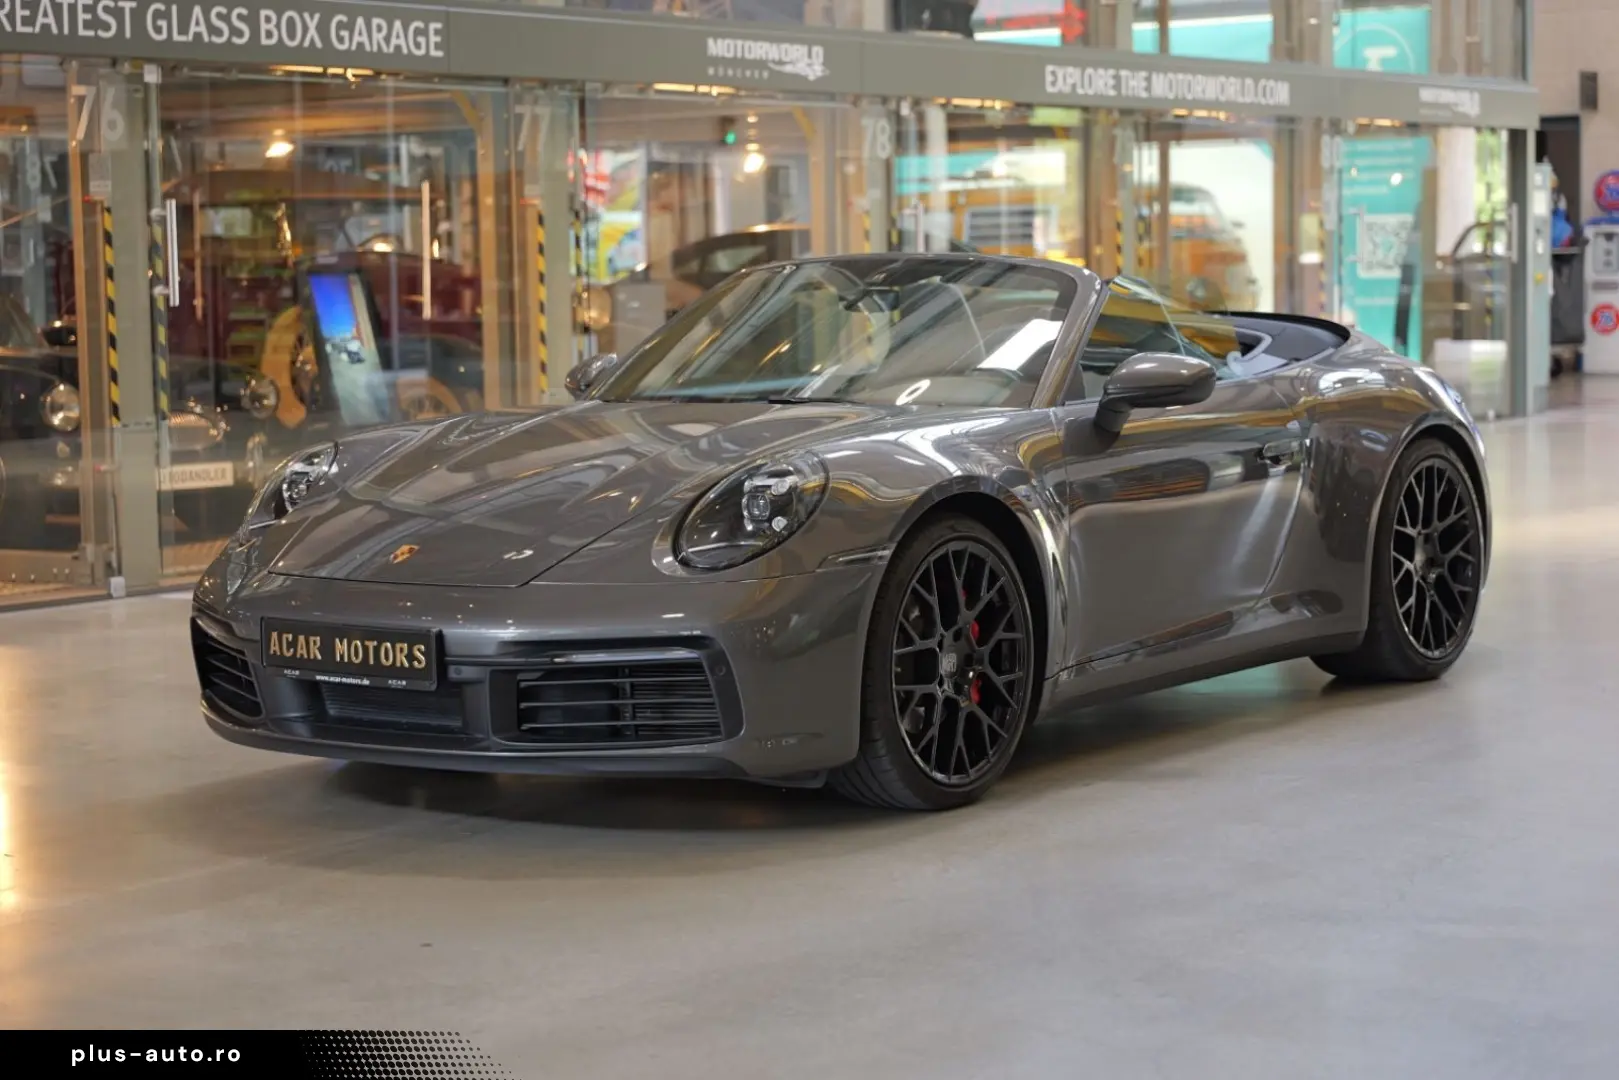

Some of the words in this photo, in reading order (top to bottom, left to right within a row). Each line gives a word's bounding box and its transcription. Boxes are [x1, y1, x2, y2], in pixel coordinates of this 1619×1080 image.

[146, 3, 250, 45] GLASS
[259, 9, 323, 49] BOX
[330, 14, 444, 57] GARAGE
[706, 36, 825, 63] MOTORWORLD
[1045, 64, 1118, 96] EXPLORE
[1119, 69, 1149, 98] THE
[1150, 71, 1290, 106] MOTORWORLD.COM
[71, 84, 125, 142] 76
[862, 117, 891, 159] 78
[269, 631, 322, 661] ACAR
[335, 637, 427, 670] MOTORS
[315, 674, 371, 686] www.acar-motors.de
